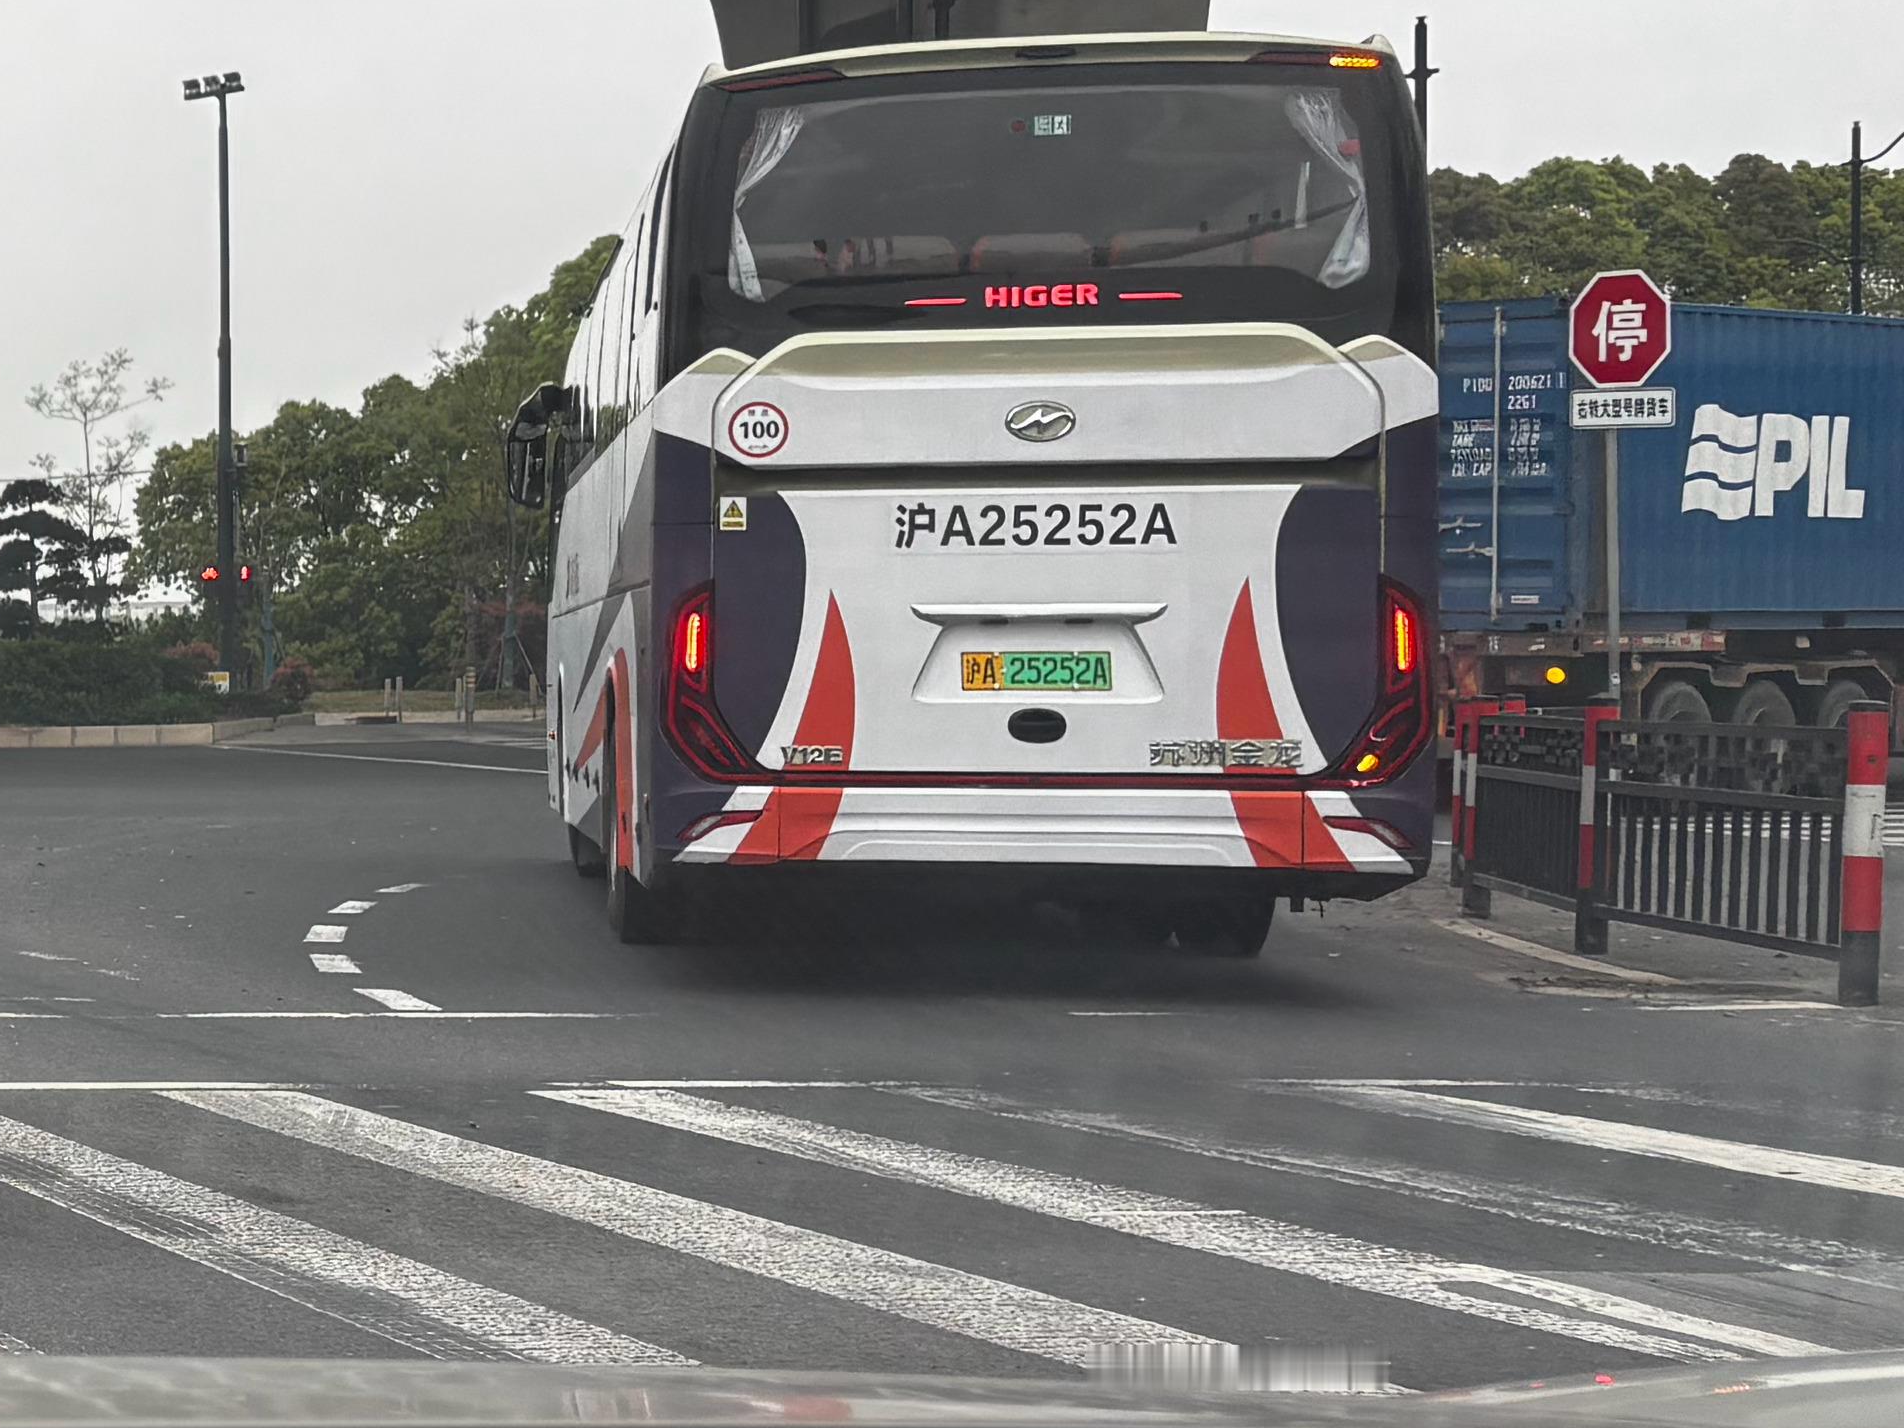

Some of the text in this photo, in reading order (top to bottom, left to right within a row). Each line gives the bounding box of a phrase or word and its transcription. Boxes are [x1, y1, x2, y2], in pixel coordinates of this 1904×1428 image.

[984, 283, 1099, 307] HIGER
[1592, 299, 1648, 362] 停
[1577, 397, 1669, 419] 右转大型号牌货车
[739, 420, 780, 439] 100
[1755, 413, 1865, 518] PIL
[895, 502, 1177, 548] 沪A25252A
